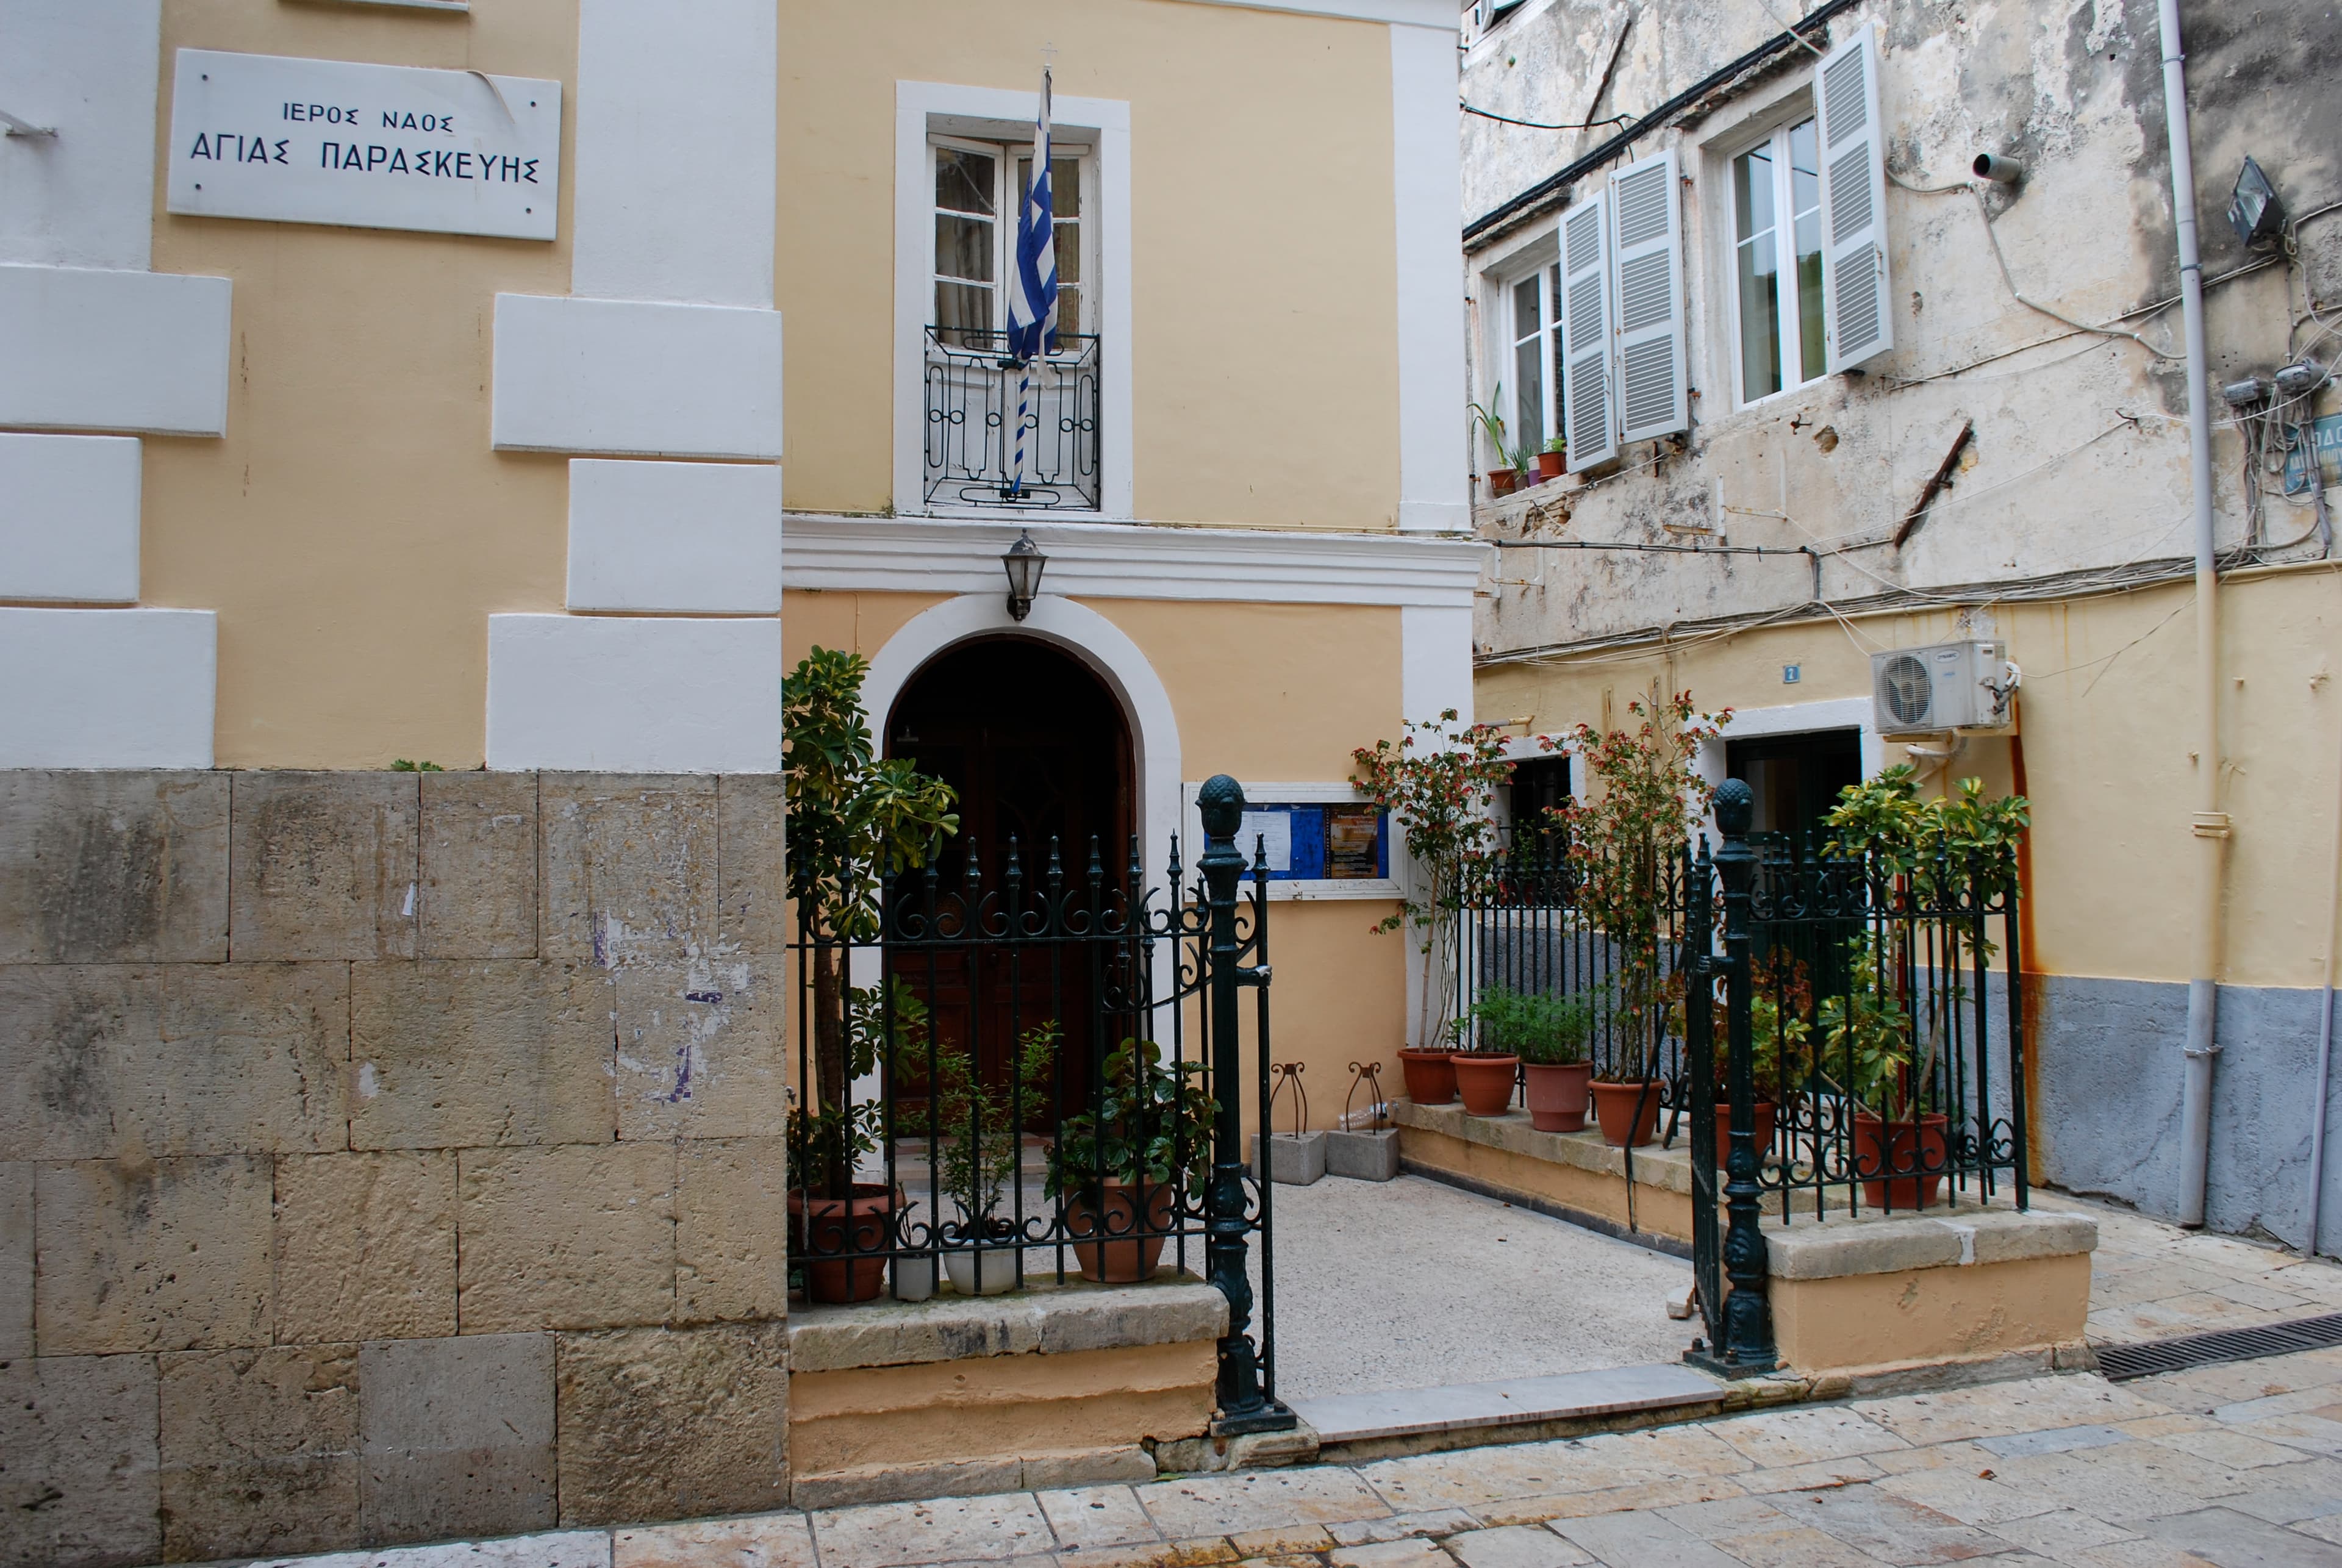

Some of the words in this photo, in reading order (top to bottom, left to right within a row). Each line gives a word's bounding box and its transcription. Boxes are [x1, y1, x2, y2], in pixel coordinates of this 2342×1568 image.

[283, 102, 359, 126] ΙΕΡΟΣ
[382, 110, 454, 133] ΝΑΟΣ
[190, 132, 290, 165] ΑΓΙΑΣ
[321, 141, 540, 184] ΠΑΡΑΣΚΕΥΗΣ
